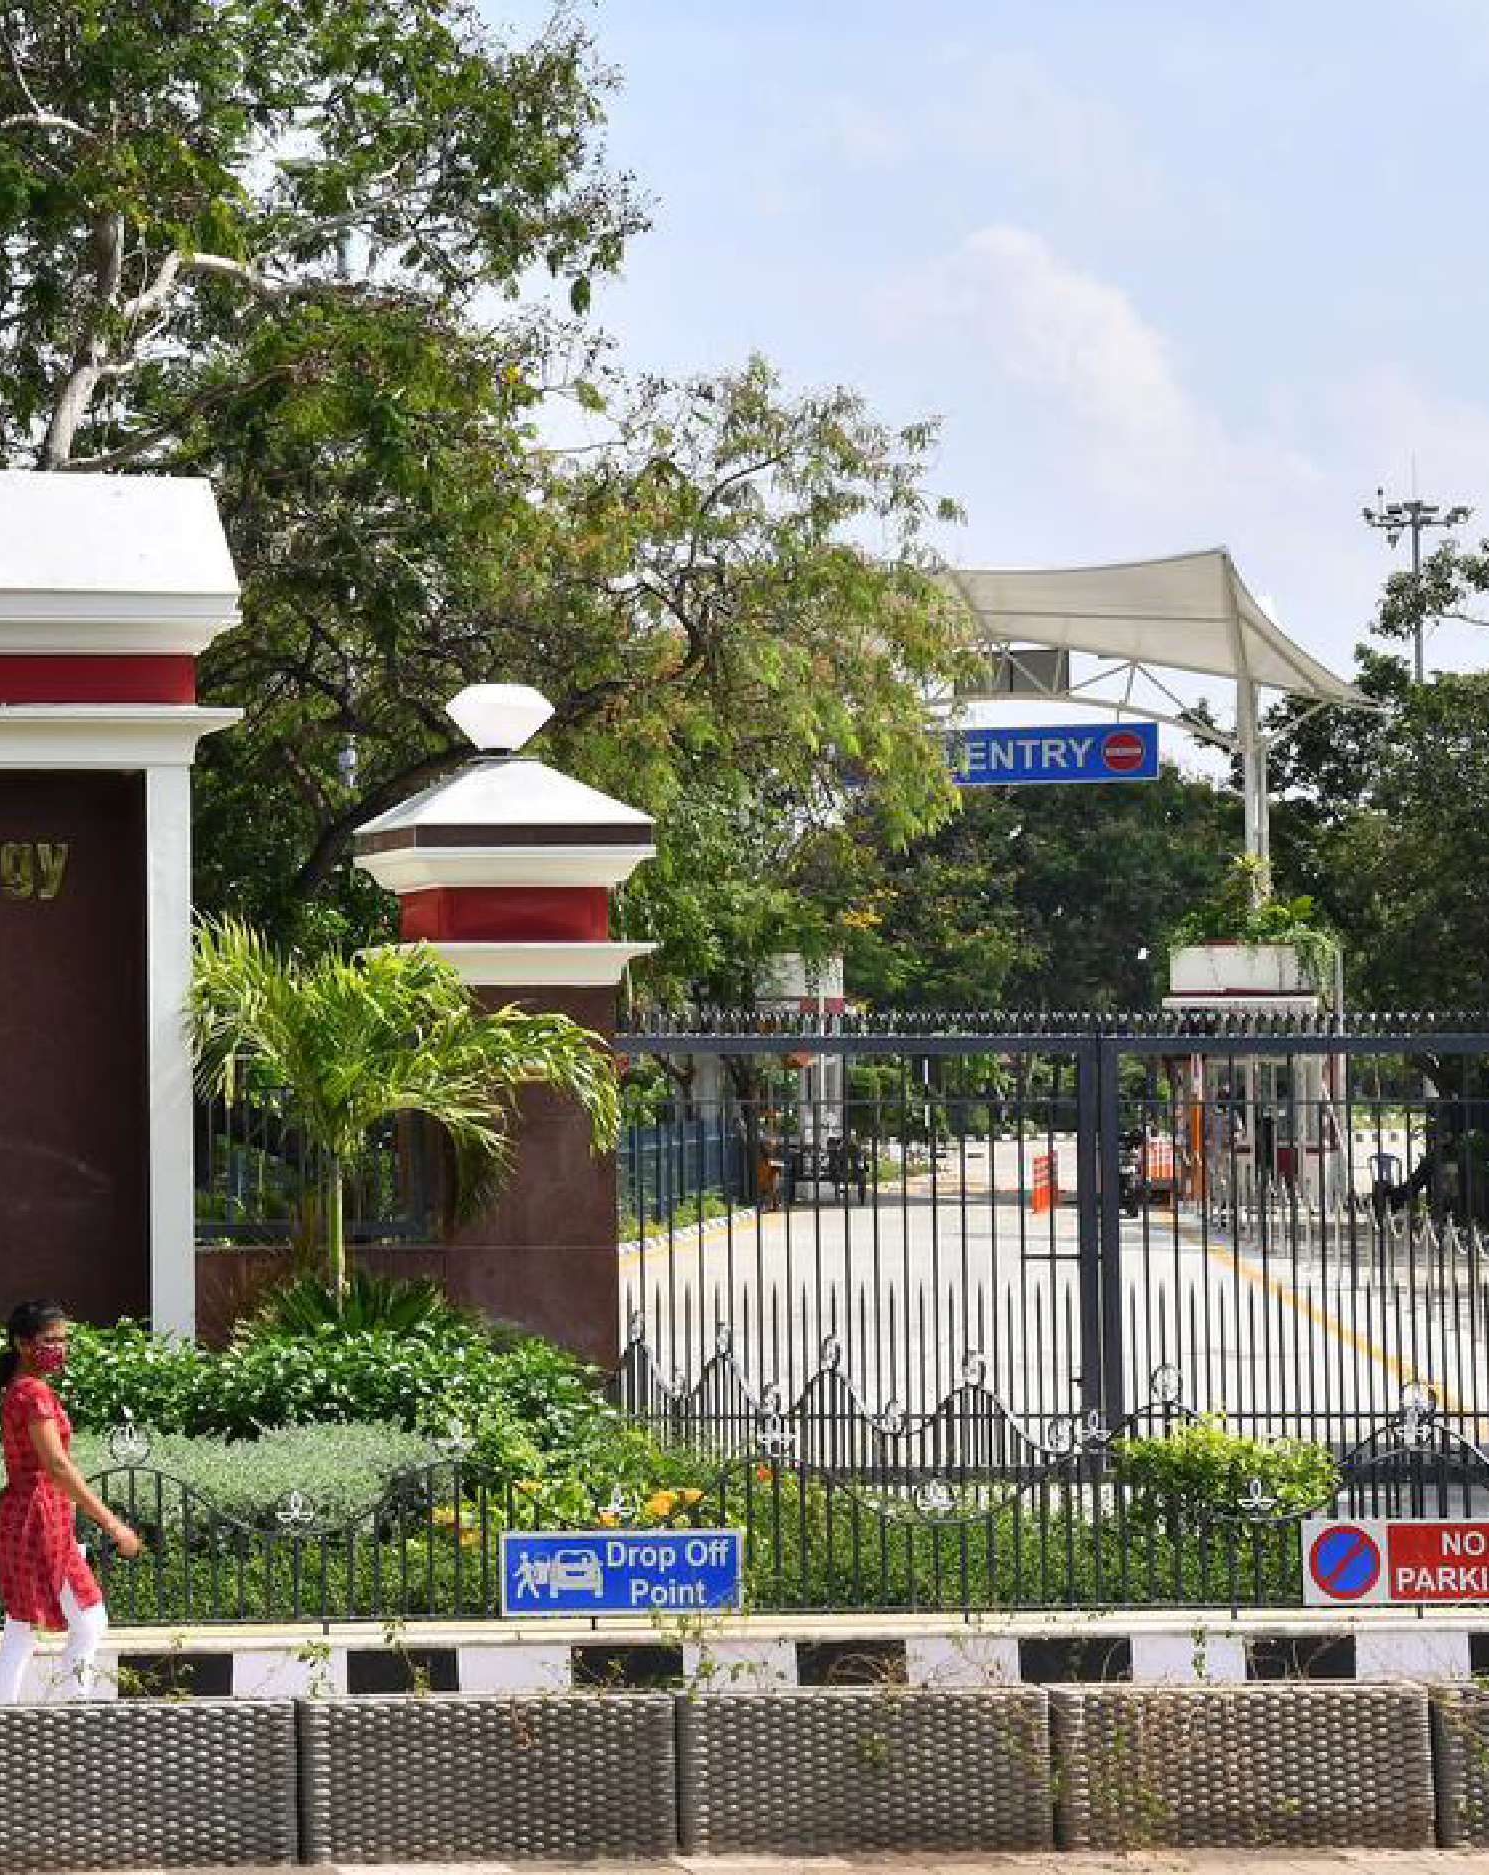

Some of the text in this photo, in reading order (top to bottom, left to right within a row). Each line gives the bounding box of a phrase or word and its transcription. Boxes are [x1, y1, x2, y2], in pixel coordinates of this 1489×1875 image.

[967, 737, 1094, 770] ENTRY
[606, 1538, 729, 1572] Drop Off
[1441, 1530, 1486, 1556] NO
[629, 1578, 708, 1607] Point
